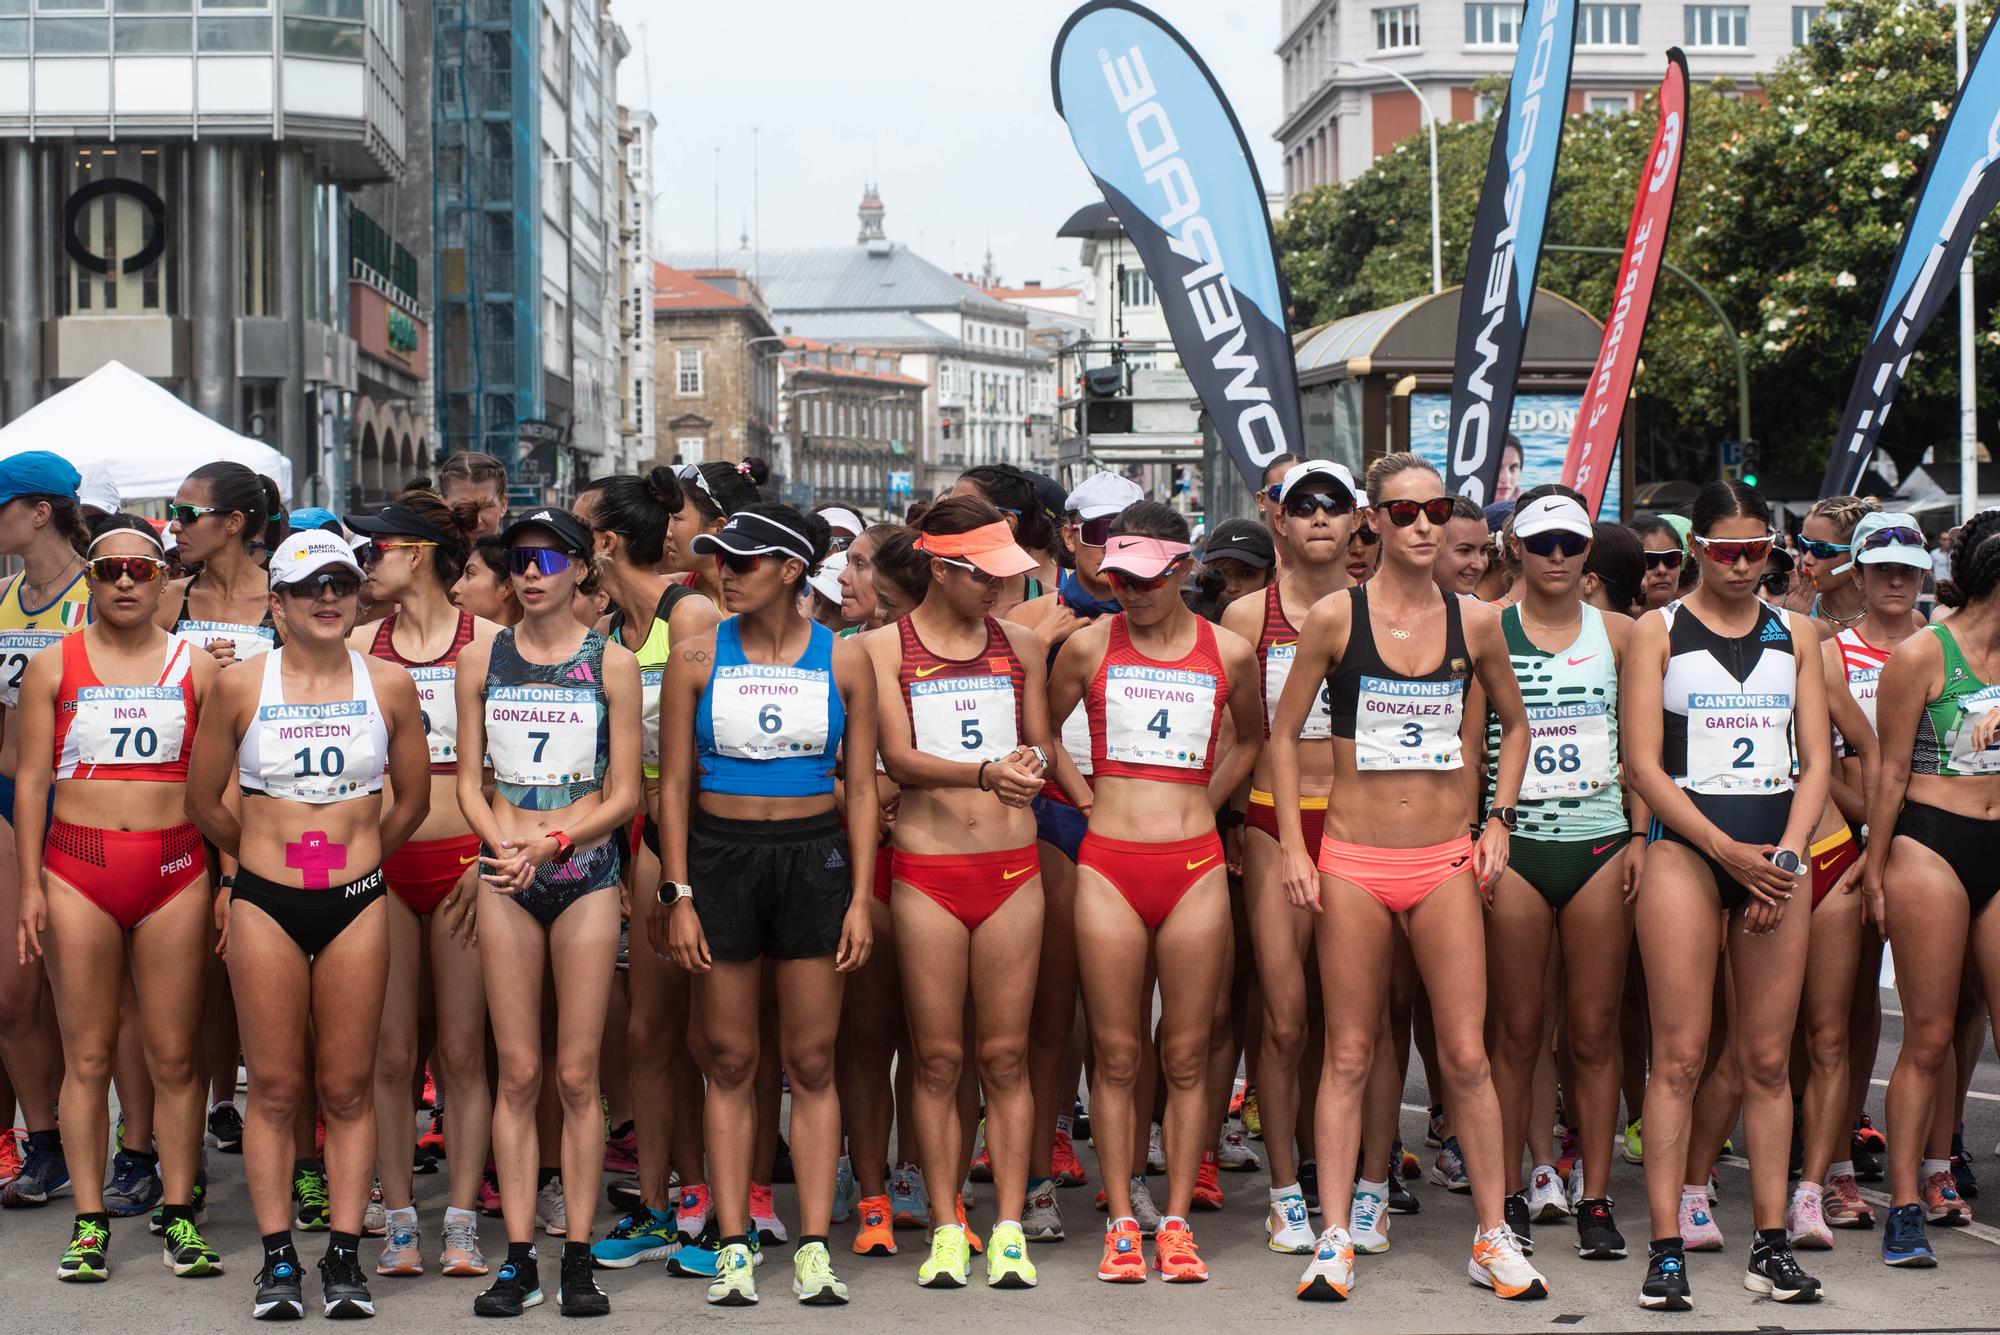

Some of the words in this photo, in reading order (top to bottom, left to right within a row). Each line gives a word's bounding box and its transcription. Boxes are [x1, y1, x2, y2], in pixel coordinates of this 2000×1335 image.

[1760, 631, 1788, 642] adidas
[722, 666, 826, 681] CANTONES23
[1113, 668, 1213, 687] CANTONES23
[84, 687, 180, 700] CANTONES23
[739, 683, 798, 696] ORTUÑO
[917, 678, 1009, 694] CANTONES23
[1368, 680, 1461, 696] CANTONES23
[494, 688, 591, 702] CANTONES23
[1124, 686, 1194, 703] QUIEYANG
[1694, 695, 1787, 708] CANTONES23
[114, 707, 147, 719] INGA
[267, 703, 364, 719] CANTONES23
[955, 699, 976, 711] LIU
[1366, 699, 1441, 716] GONZÁLEZ
[1444, 703, 1455, 715] R.
[1525, 703, 1602, 719] NTONES23
[492, 707, 565, 723] GONZÁLEZ
[569, 711, 584, 724] A.
[758, 703, 783, 734] 6
[1146, 708, 1171, 739] 4
[1705, 713, 1758, 729] GARCÍA
[1762, 717, 1775, 728] K.
[280, 724, 351, 739] MOREJON
[961, 719, 983, 750] 5
[1400, 722, 1423, 748] 3
[1530, 725, 1577, 738] RAMOS
[110, 727, 158, 757] 70
[527, 731, 551, 763] 7
[1534, 743, 1581, 775] 68
[1732, 737, 1755, 769] 2
[294, 746, 345, 778] 10
[160, 852, 193, 877] PERÚ
[345, 872, 378, 898] NIKE
